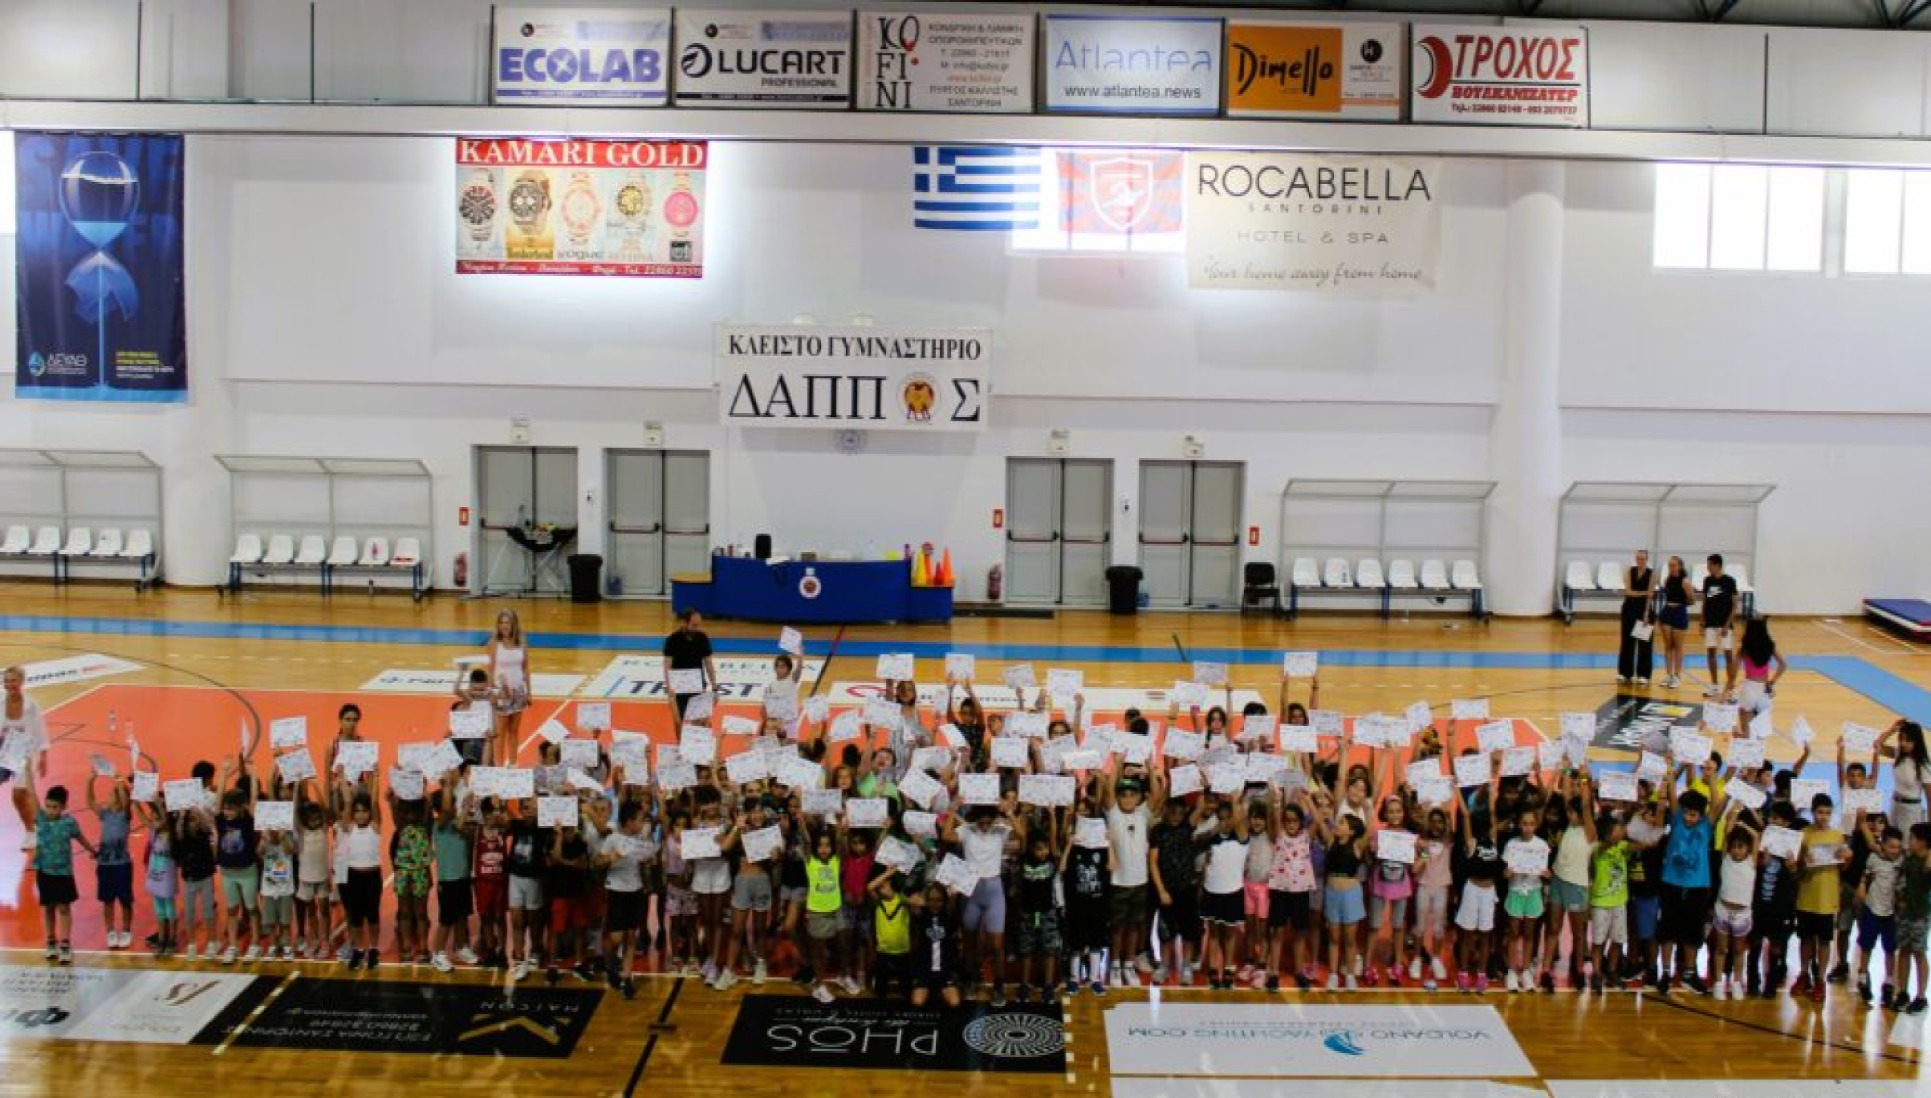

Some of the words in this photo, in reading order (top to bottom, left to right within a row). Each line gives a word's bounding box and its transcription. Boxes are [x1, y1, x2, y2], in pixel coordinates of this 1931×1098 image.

[499, 47, 661, 83] ECOLAB
[718, 50, 846, 76] LUCART
[1055, 39, 1212, 72] Atlantea
[1454, 35, 1580, 80] ΤΡΟΧΟΣ
[1233, 43, 1334, 96] Dimello
[761, 77, 837, 88] PROFESSIONAL
[1065, 85, 1201, 99] www.atlantea.news
[1452, 85, 1577, 102] ΒΟΥΛΚΑΝΙΖΑΤΕΡ
[459, 142, 595, 165] KAMARI
[606, 143, 704, 167] GOLD
[1198, 165, 1431, 201] ROCABELLA
[1249, 203, 1382, 215] SANTORINI
[1237, 230, 1307, 244] HOTEL
[1320, 231, 1333, 244] &
[1347, 232, 1390, 244] SPA
[729, 335, 822, 356] ΚΛΕΙΣΤΟ
[827, 337, 981, 360] ΓΥΜΝΑΣΤΗΡΙΟ
[1370, 1028, 1492, 1041] VOLCANO
